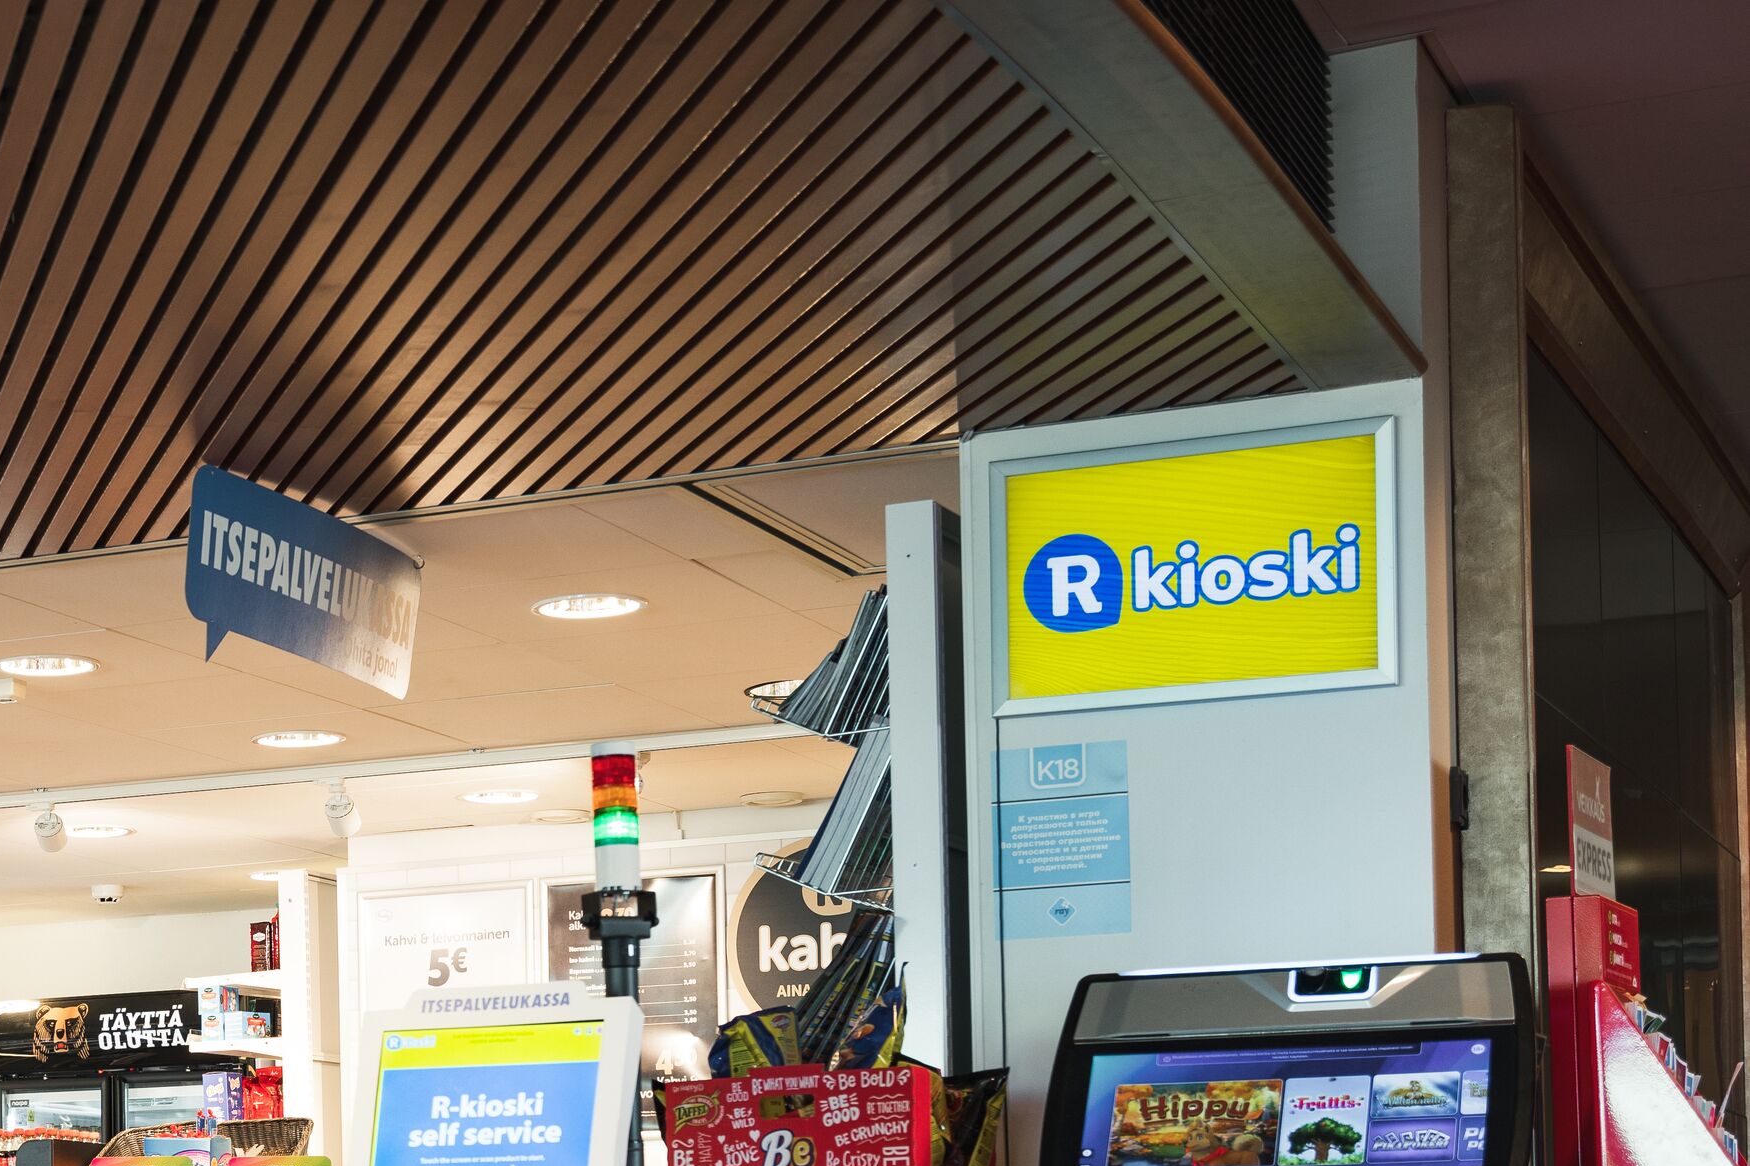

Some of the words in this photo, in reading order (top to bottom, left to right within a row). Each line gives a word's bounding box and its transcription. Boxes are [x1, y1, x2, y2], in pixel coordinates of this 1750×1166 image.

[1046, 554, 1103, 617] R
[1133, 525, 1359, 611] kioski
[1037, 758, 1080, 782] K18
[1576, 836, 1612, 884] EXPRESS
[384, 932, 416, 947] Kahvi
[420, 932, 428, 944] &
[427, 946, 468, 987] 5€
[420, 992, 571, 1014] ITSEPALVELUKASSA
[98, 1004, 184, 1031] TÄYTTÄ
[98, 1027, 188, 1051] OLUTTA
[762, 1077, 785, 1092] WHAT
[784, 1076, 799, 1089] YOU
[799, 1074, 820, 1089] WANT
[430, 1091, 545, 1119] R-kioski
[726, 1091, 749, 1103] GOOD
[876, 1099, 911, 1114] TOGETHER
[1139, 1094, 1251, 1122] Hippu
[407, 1121, 460, 1148] self
[462, 1119, 562, 1146] service
[731, 1116, 756, 1129] WILD
[851, 1120, 910, 1140] CRUNCHY
